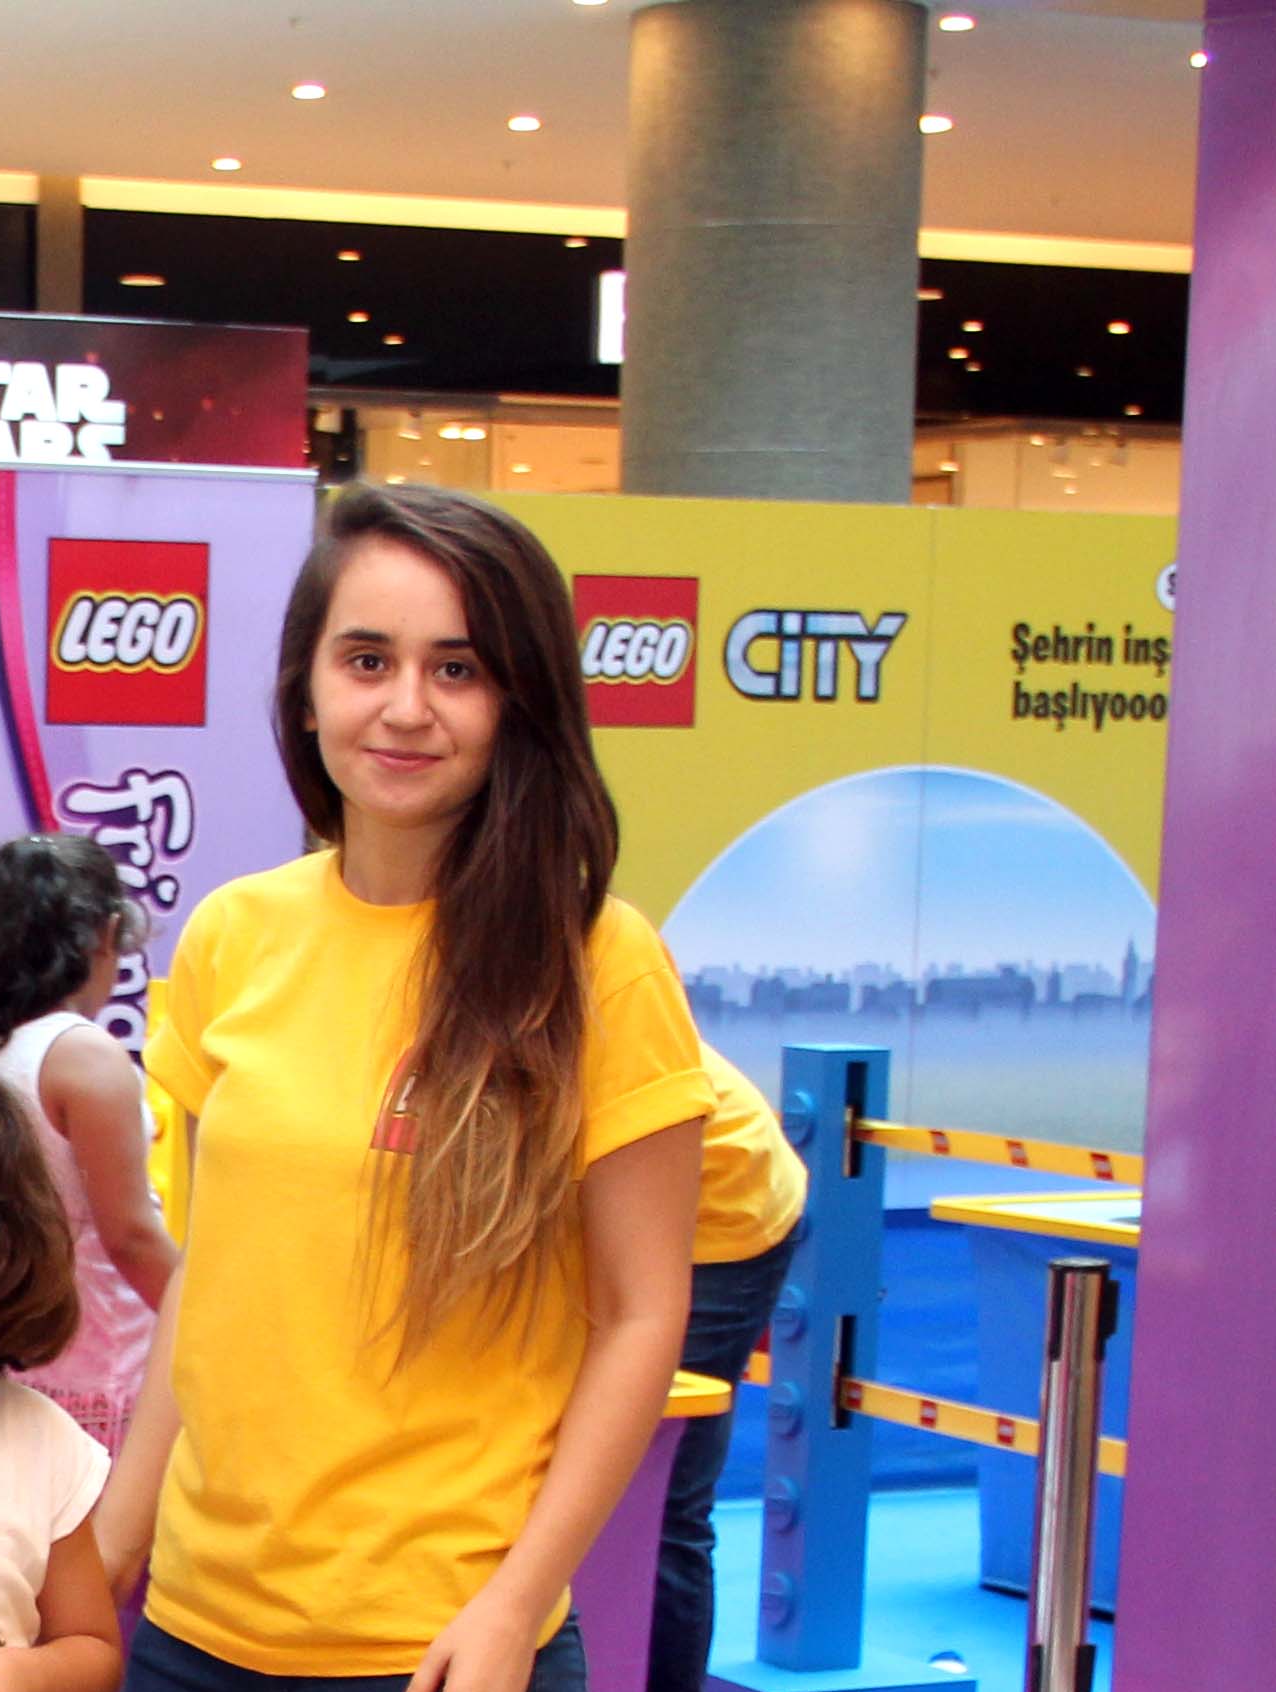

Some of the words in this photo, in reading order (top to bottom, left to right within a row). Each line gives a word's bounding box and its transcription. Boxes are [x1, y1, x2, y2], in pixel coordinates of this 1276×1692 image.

[59, 596, 197, 666] LEGO
[580, 620, 691, 680] LEGO
[723, 608, 909, 703] CITY
[1012, 622, 1113, 675] Şehrin
[1012, 681, 1168, 732] başlıyooo
